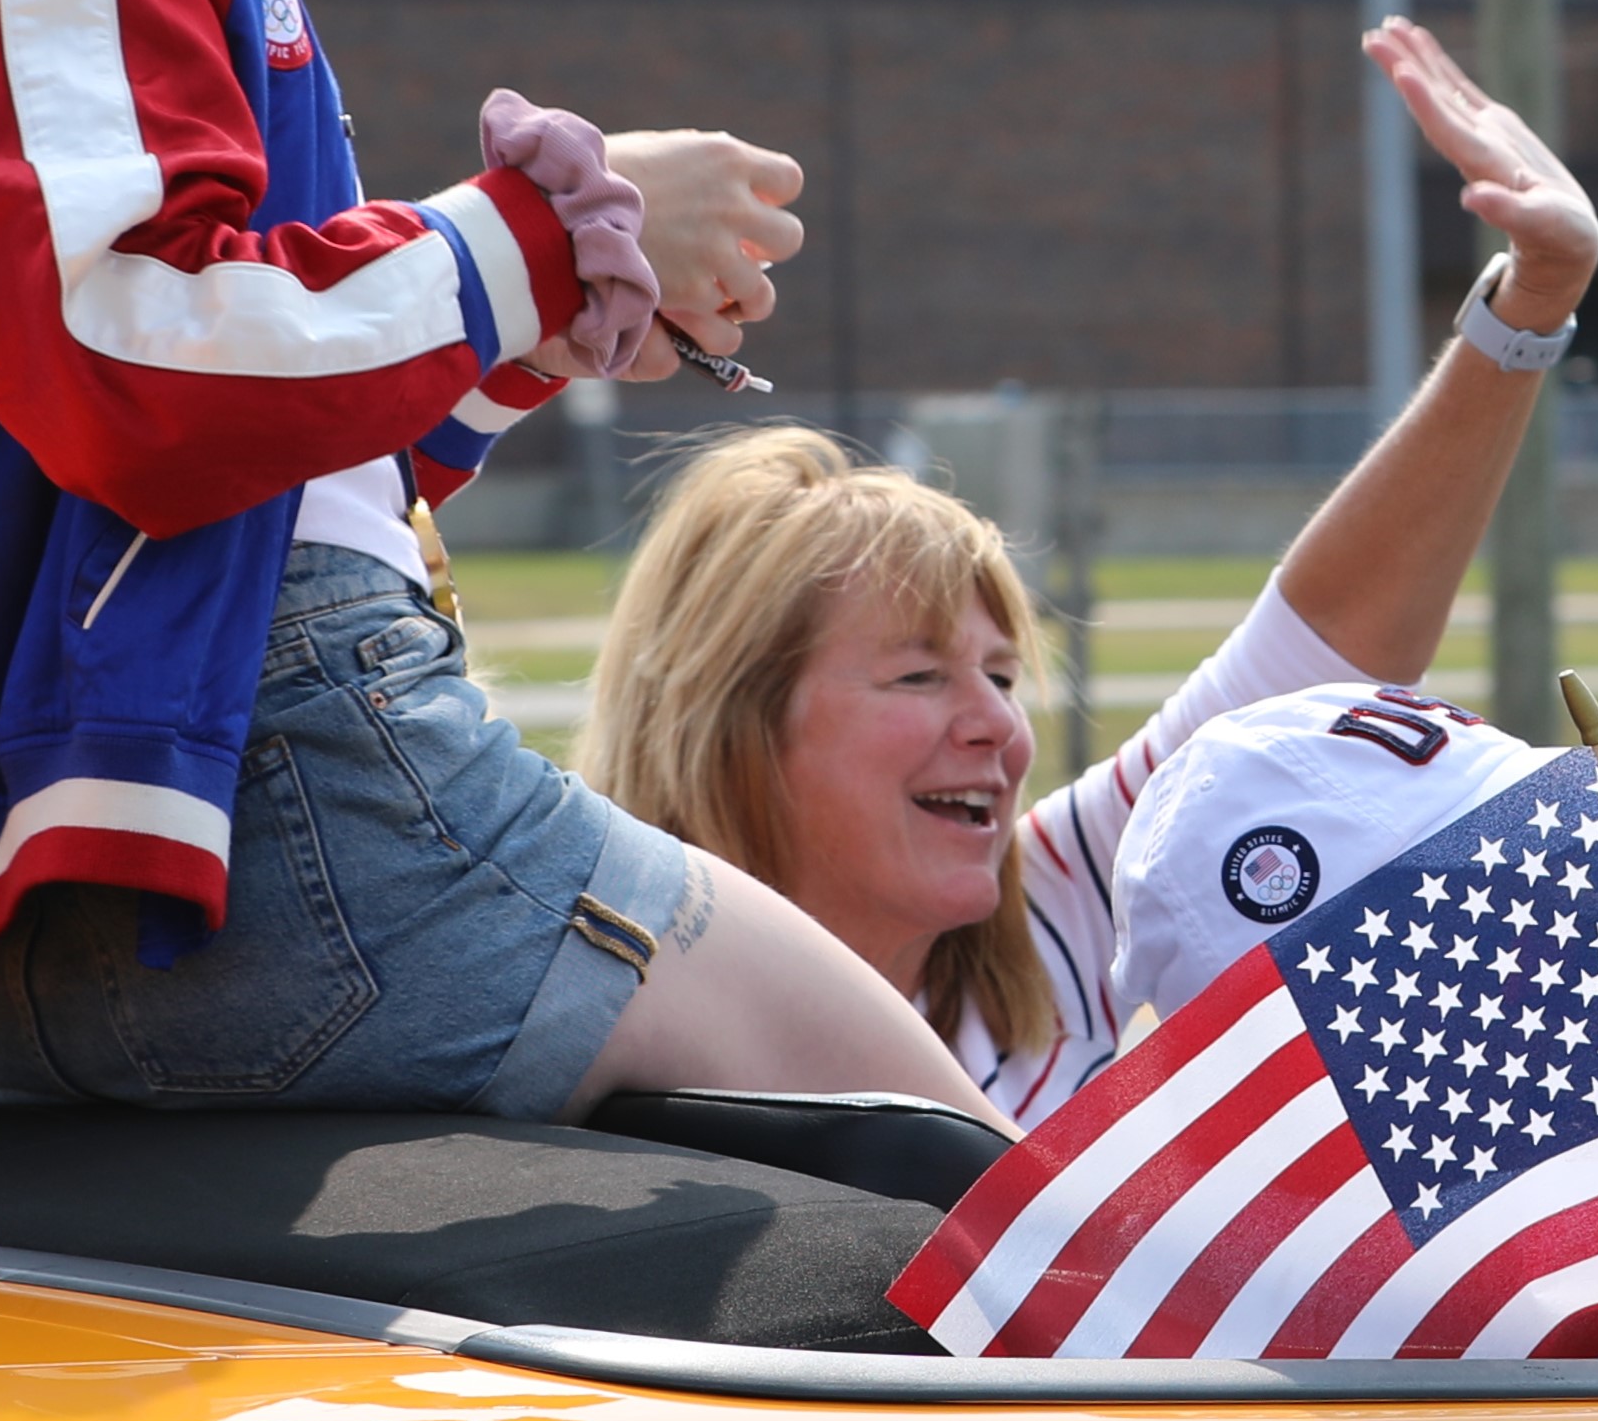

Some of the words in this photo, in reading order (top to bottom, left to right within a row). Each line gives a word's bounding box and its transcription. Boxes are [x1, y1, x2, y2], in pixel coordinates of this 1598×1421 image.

[1229, 846, 1248, 881] UNITED
[1247, 834, 1283, 848] STATES
[1260, 899, 1300, 917] OLYMPIC
[1297, 871, 1312, 897] TEAM
